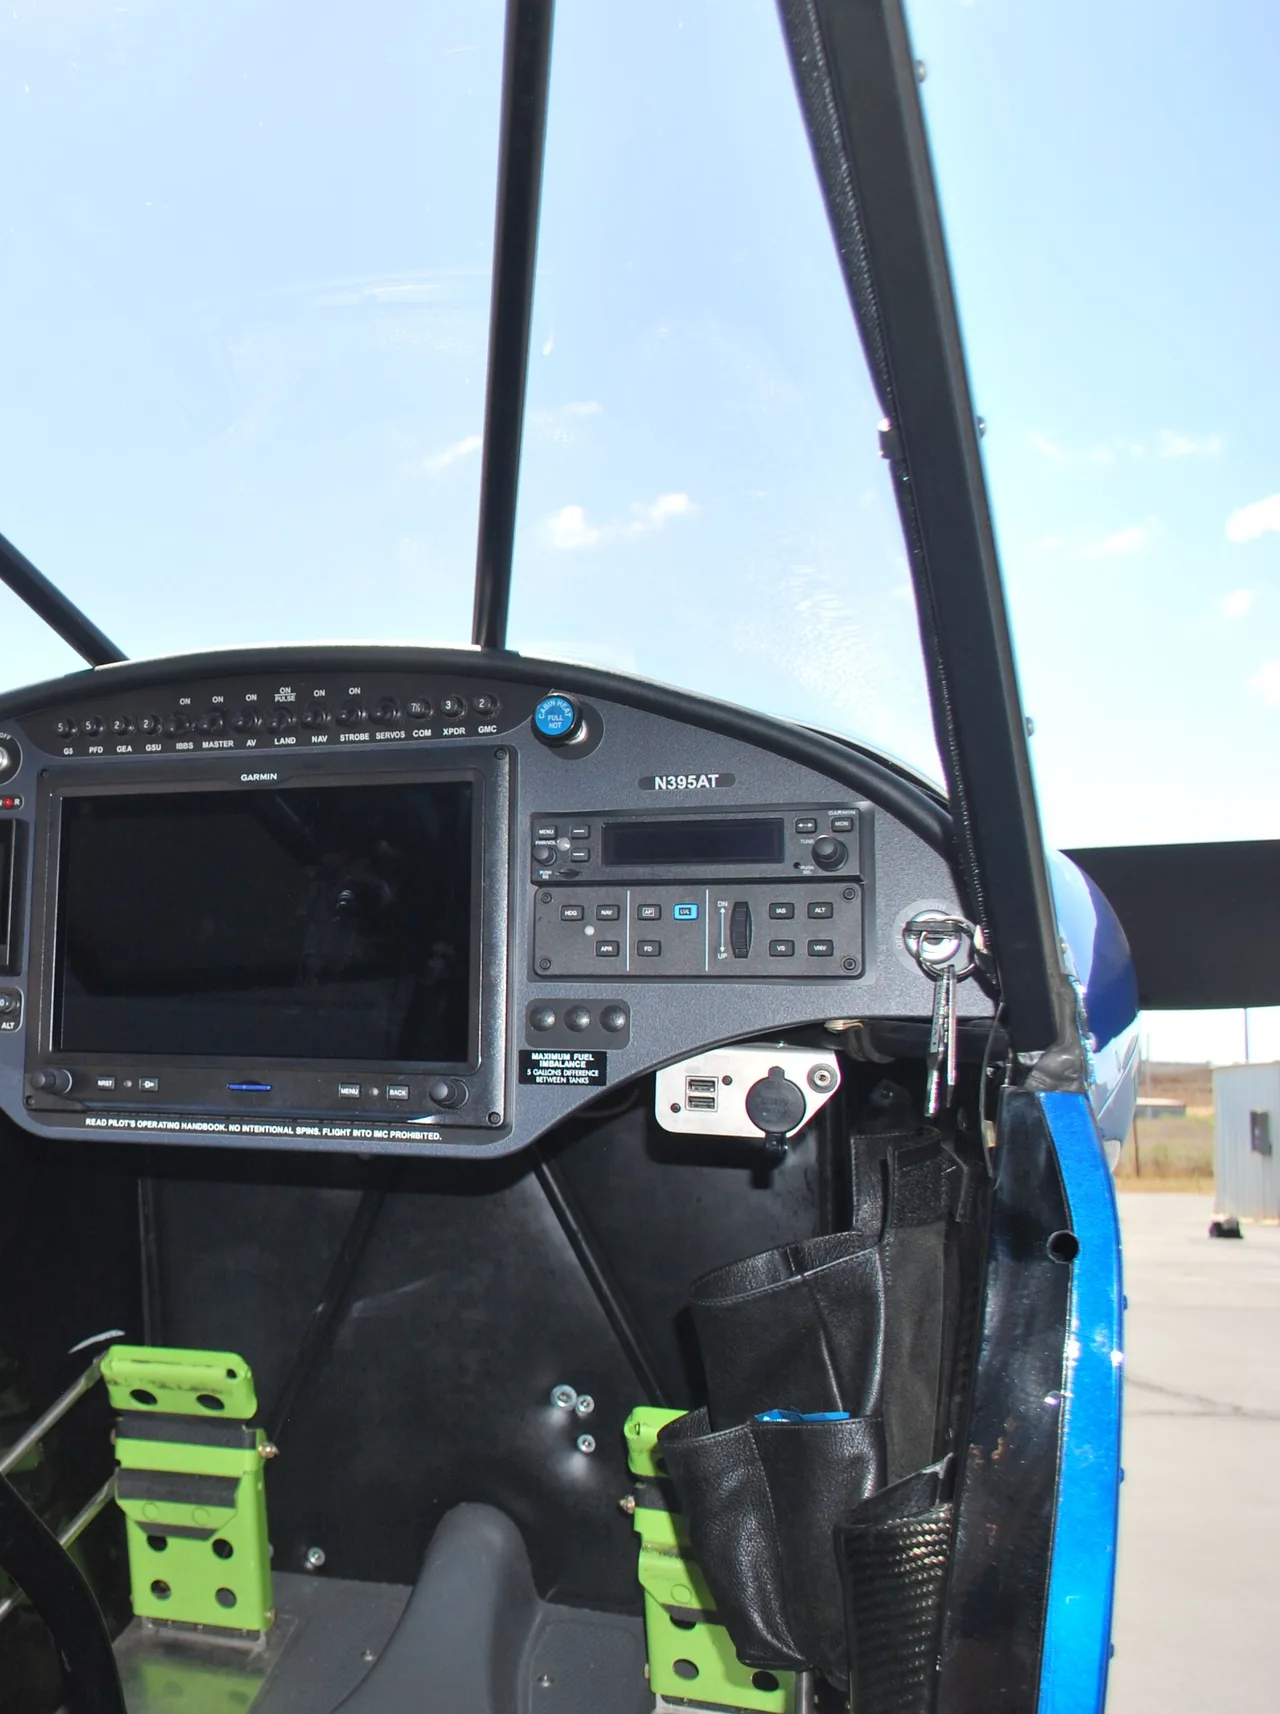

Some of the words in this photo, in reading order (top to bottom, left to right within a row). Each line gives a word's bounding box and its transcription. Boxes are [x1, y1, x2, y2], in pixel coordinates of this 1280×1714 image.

[313, 689, 325, 697] ON
[349, 687, 361, 695] ON
[445, 700, 451, 709] 3
[539, 700, 556, 719] CABIN
[557, 700, 571, 717] HEAT
[413, 729, 431, 737] COM
[443, 727, 465, 735] XPDR
[478, 725, 497, 733] GMC
[340, 733, 370, 741] STROBE
[376, 731, 405, 739] SERVOS
[202, 740, 234, 748] MASTER
[274, 737, 296, 745] LAND
[89, 746, 103, 754] PFD
[116, 745, 132, 753] GEA
[176, 742, 193, 750] IBBS
[241, 773, 277, 781] GARMIN
[655, 774, 719, 790] N395AT
[86, 1118, 106, 1126] READ
[108, 1119, 135, 1127] PILOT'S
[137, 1121, 180, 1129] OPERATING
[181, 1122, 227, 1131] HANDBOOK.
[242, 1126, 294, 1135] INTENTIONAL
[296, 1127, 321, 1135] SPINS.
[322, 1128, 351, 1136] FLIGHT
[353, 1129, 371, 1137] INTO
[374, 1130, 388, 1138] IMC
[390, 1131, 442, 1140] PROHIBITED.
